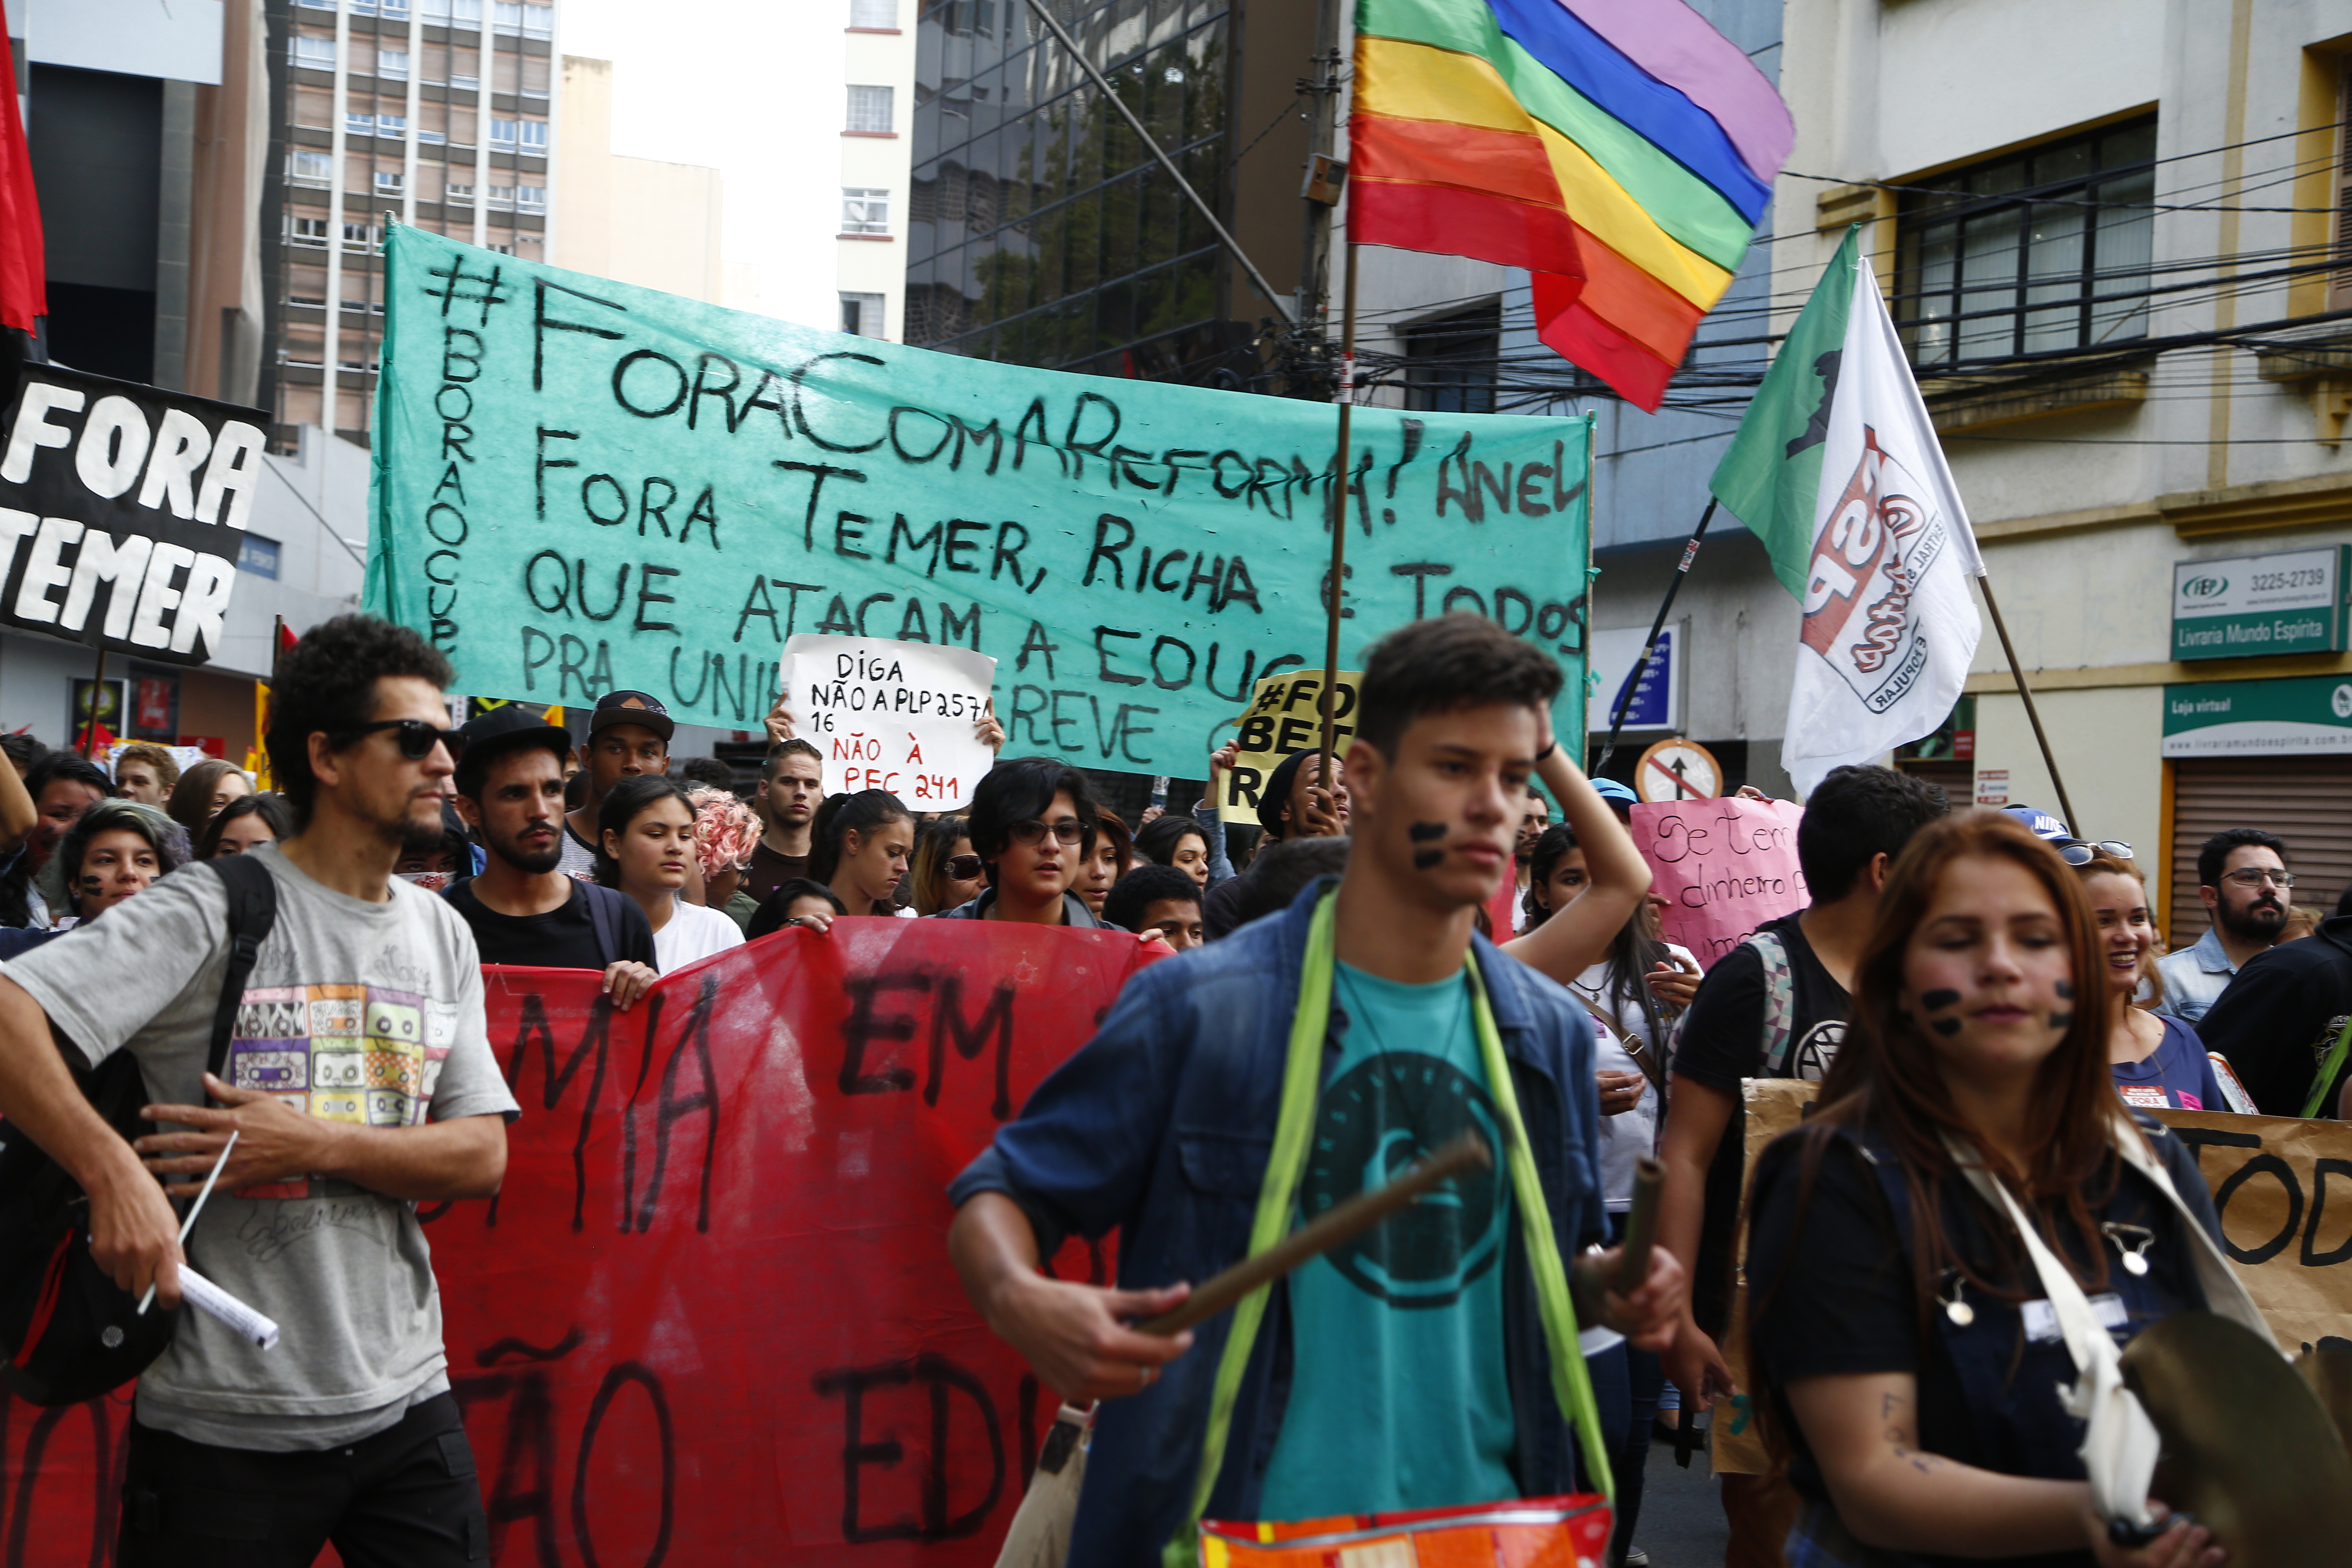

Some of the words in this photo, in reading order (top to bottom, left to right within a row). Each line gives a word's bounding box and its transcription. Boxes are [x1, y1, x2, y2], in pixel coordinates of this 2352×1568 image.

[532, 276, 793, 439] FORA
[1436, 430, 1585, 524] ANEL
[0, 381, 267, 530] FORA
[536, 422, 722, 552] FORA
[771, 459, 1047, 594] TEMER,
[1081, 512, 1263, 614] RICHA
[1389, 561, 1585, 654] TODOS
[0, 506, 237, 658] TEMER
[2251, 568, 2325, 591] 3225-2739
[526, 549, 681, 635] QUE
[734, 574, 982, 651] ATACAM
[1016, 620, 1059, 681] A
[2178, 625, 2223, 647] Livraria
[2226, 622, 2271, 643] Mundo
[521, 626, 614, 702] PRA
[991, 684, 1159, 764] REVE
[811, 679, 865, 711] NÃO
[872, 689, 888, 712] A
[895, 690, 931, 715] PLP
[2172, 700, 2193, 716] Loja
[2196, 697, 2231, 712] virtual
[811, 711, 835, 733] 16
[832, 732, 881, 762] NÃO
[906, 732, 924, 764] À
[844, 767, 900, 794] PEC
[915, 774, 958, 799] 241
[1653, 815, 1713, 863] Se
[1715, 807, 1797, 855] Tem
[1681, 863, 1785, 909] dinheiro
[414, 975, 721, 1234] MIA
[837, 969, 1015, 1120] EM
